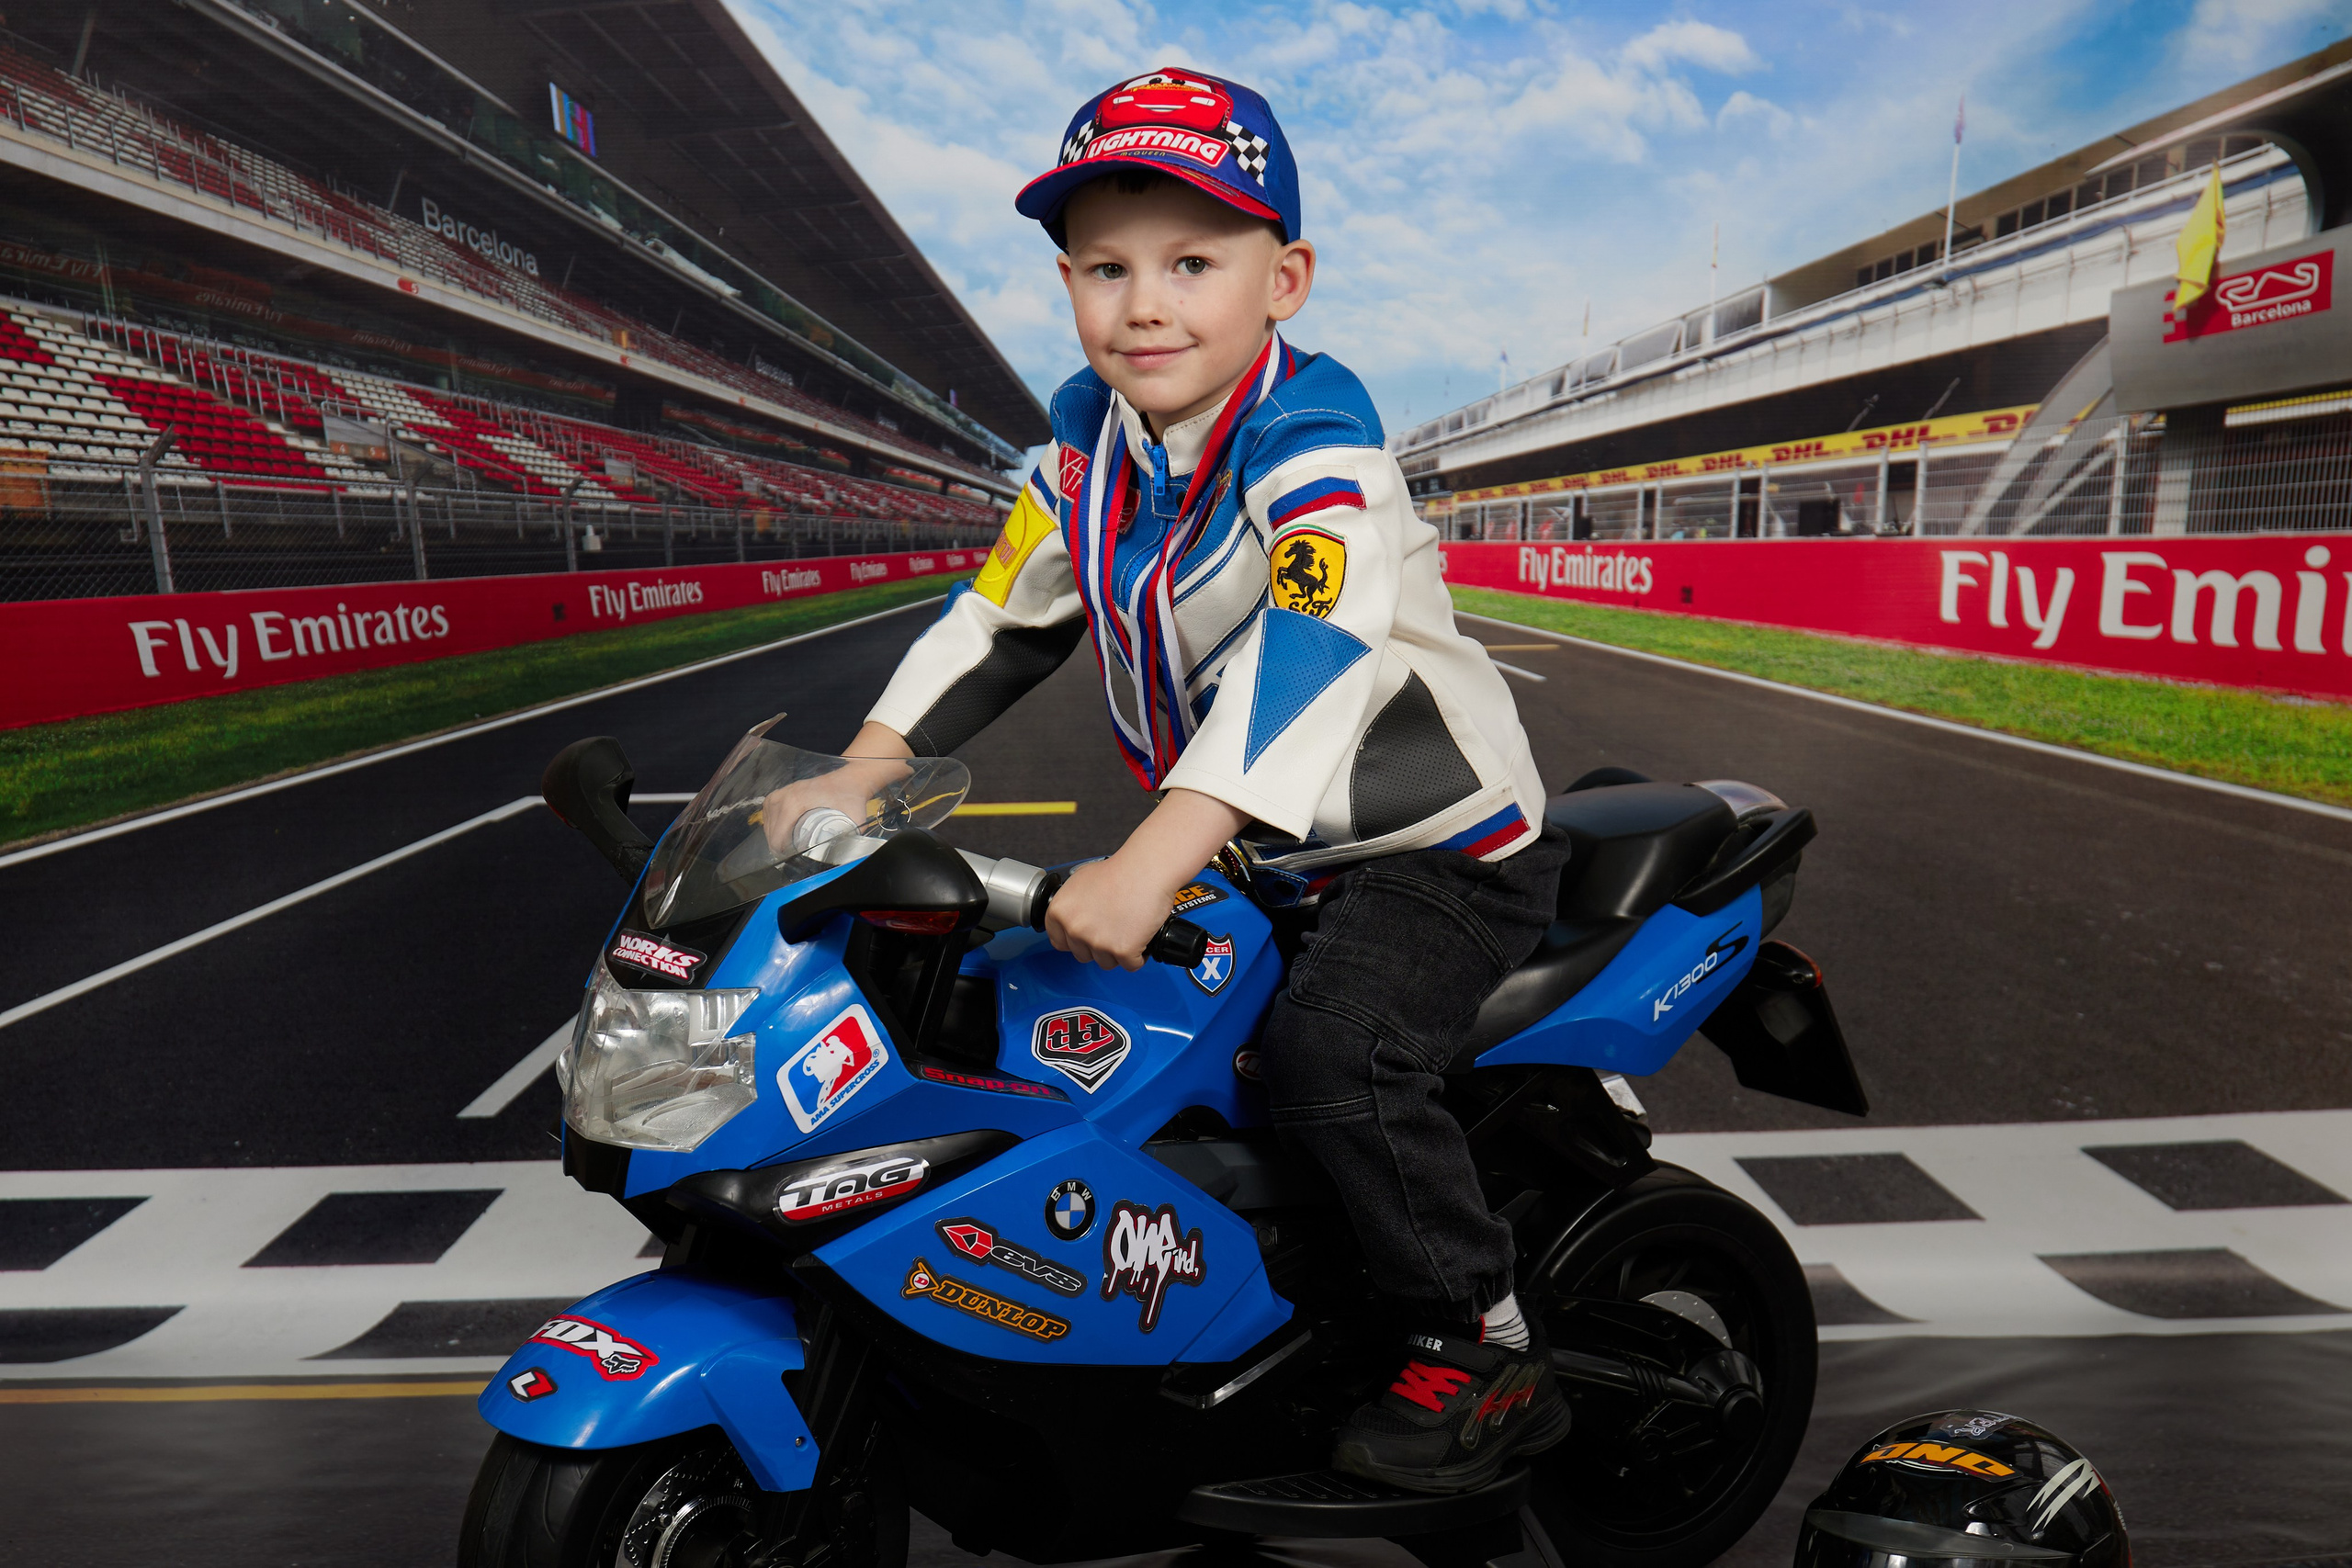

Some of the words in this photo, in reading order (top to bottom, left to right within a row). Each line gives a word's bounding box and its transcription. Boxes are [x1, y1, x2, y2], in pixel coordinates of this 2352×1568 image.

[1088, 130, 1222, 161] LIGHTNING
[423, 197, 538, 276] Barcelona
[2231, 300, 2312, 327] Barcelona
[1862, 424, 1939, 449] DHL
[1702, 453, 1746, 471] DHL
[1771, 441, 1830, 462] DHL
[1645, 463, 1684, 479] DHL
[762, 570, 781, 596] Fly
[782, 568, 821, 591] Emirates
[1518, 546, 1550, 592] Fly
[1551, 545, 1653, 594] Emirates
[588, 584, 626, 620] Fly
[628, 578, 704, 613] Emirates
[1940, 550, 2076, 649] Fly
[2099, 545, 2352, 657] Emi
[128, 617, 238, 679] Fly
[250, 603, 449, 661] Emirates
[1176, 893, 1216, 911] SYSTEMS
[620, 934, 700, 967] WORKS
[1202, 957, 1223, 980] X
[809, 1106, 831, 1126] AMA
[830, 1059, 880, 1108] SUPERCROSS
[922, 1066, 1050, 1095] Snap-on
[781, 1159, 915, 1208] TAG
[1050, 1181, 1092, 1201] BMW
[821, 1191, 883, 1212] METALS
[931, 1279, 1068, 1339] DUNLOP
[527, 1318, 645, 1359] FOX
[1408, 1334, 1443, 1352] BIKER
